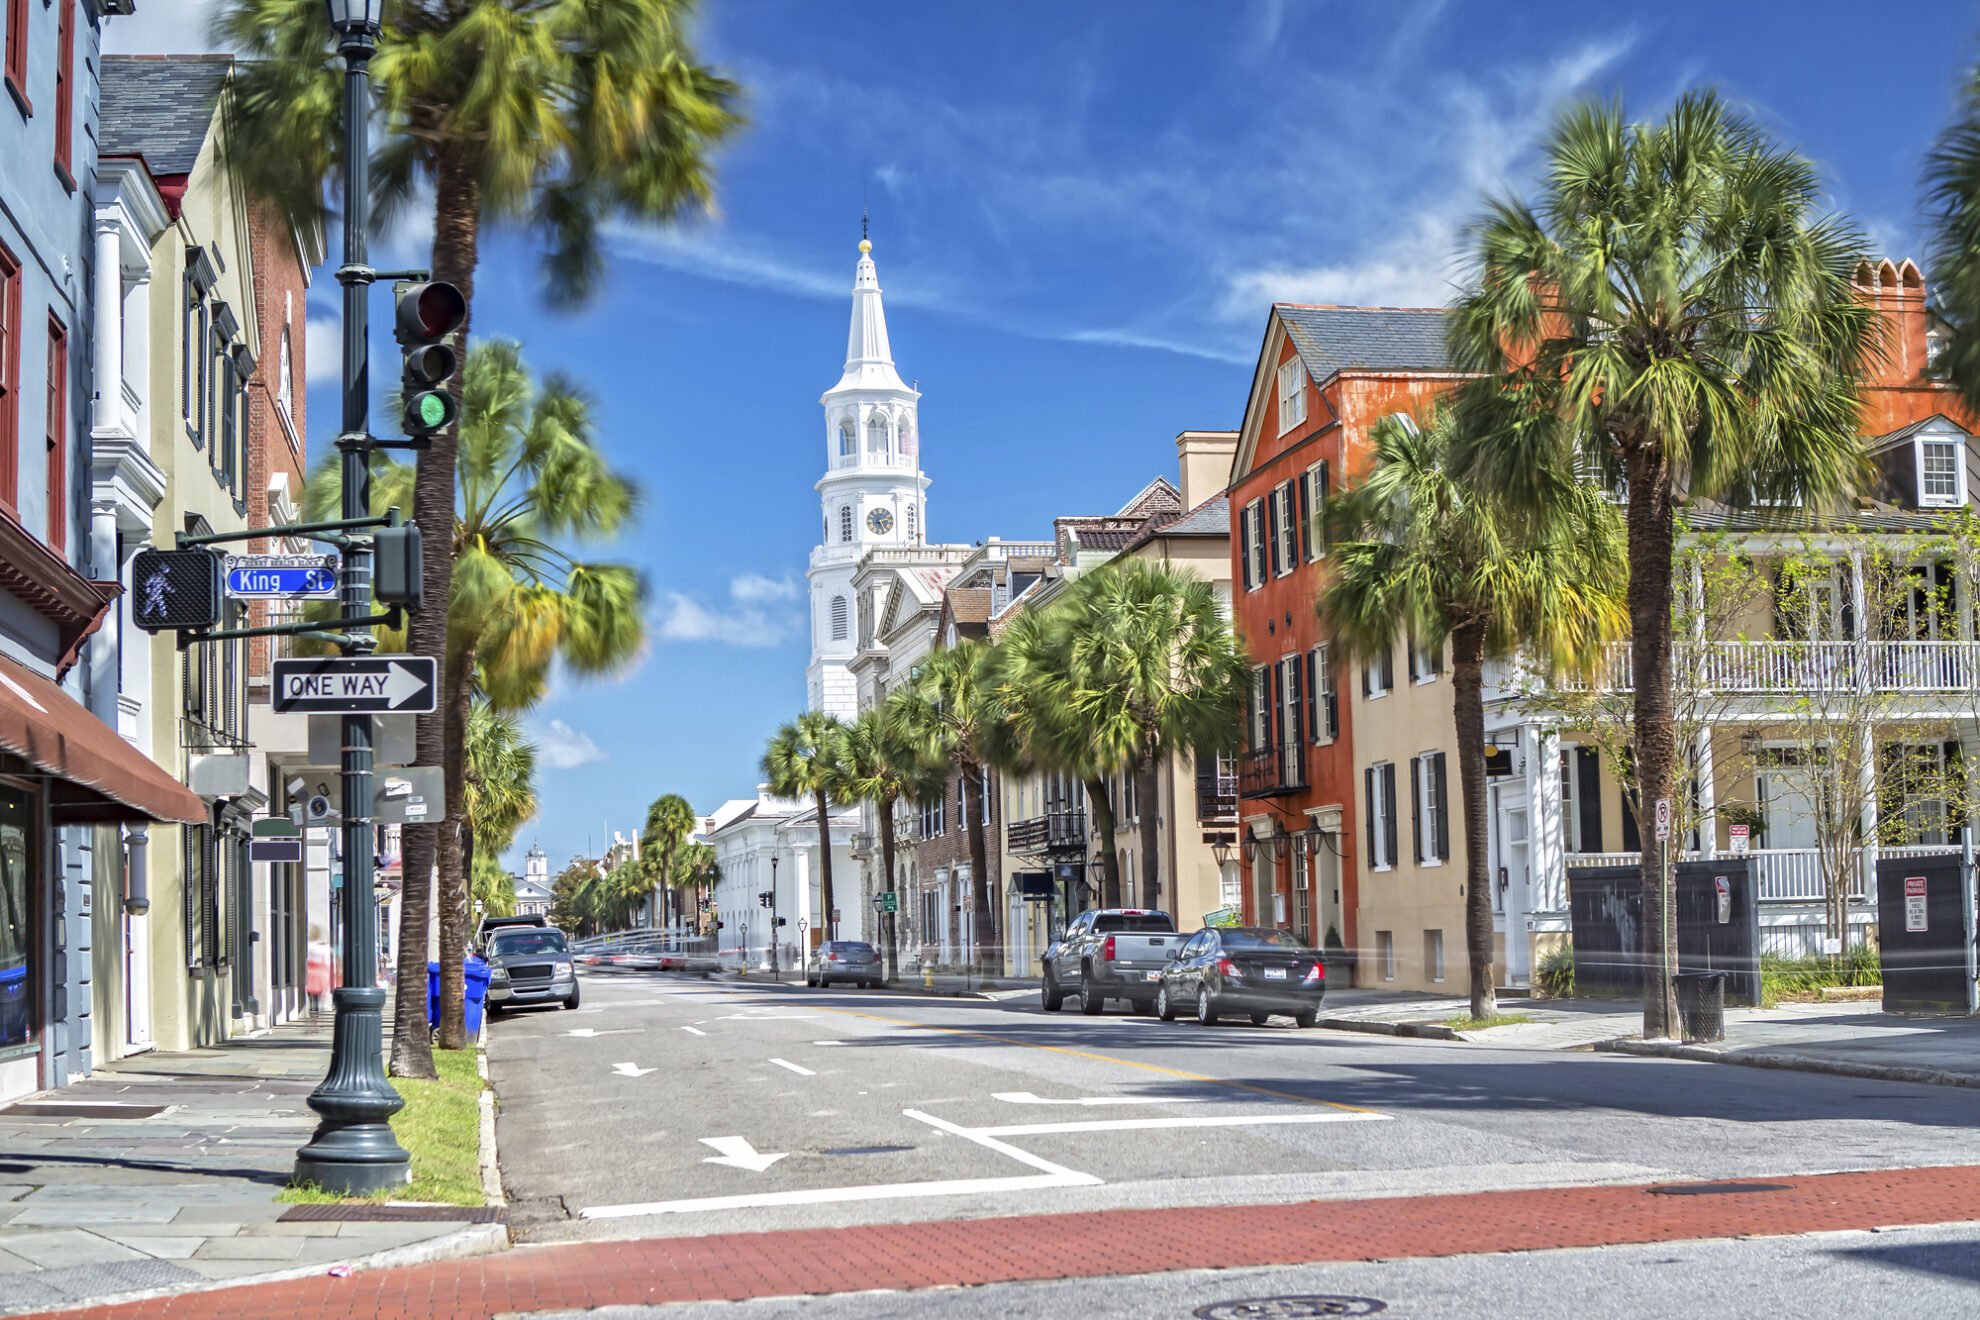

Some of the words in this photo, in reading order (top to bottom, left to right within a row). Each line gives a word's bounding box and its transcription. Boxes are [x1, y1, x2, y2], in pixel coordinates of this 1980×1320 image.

[240, 570, 280, 591] King
[305, 570, 325, 590] St
[290, 676, 334, 696] ONE
[342, 675, 388, 696] WAY
